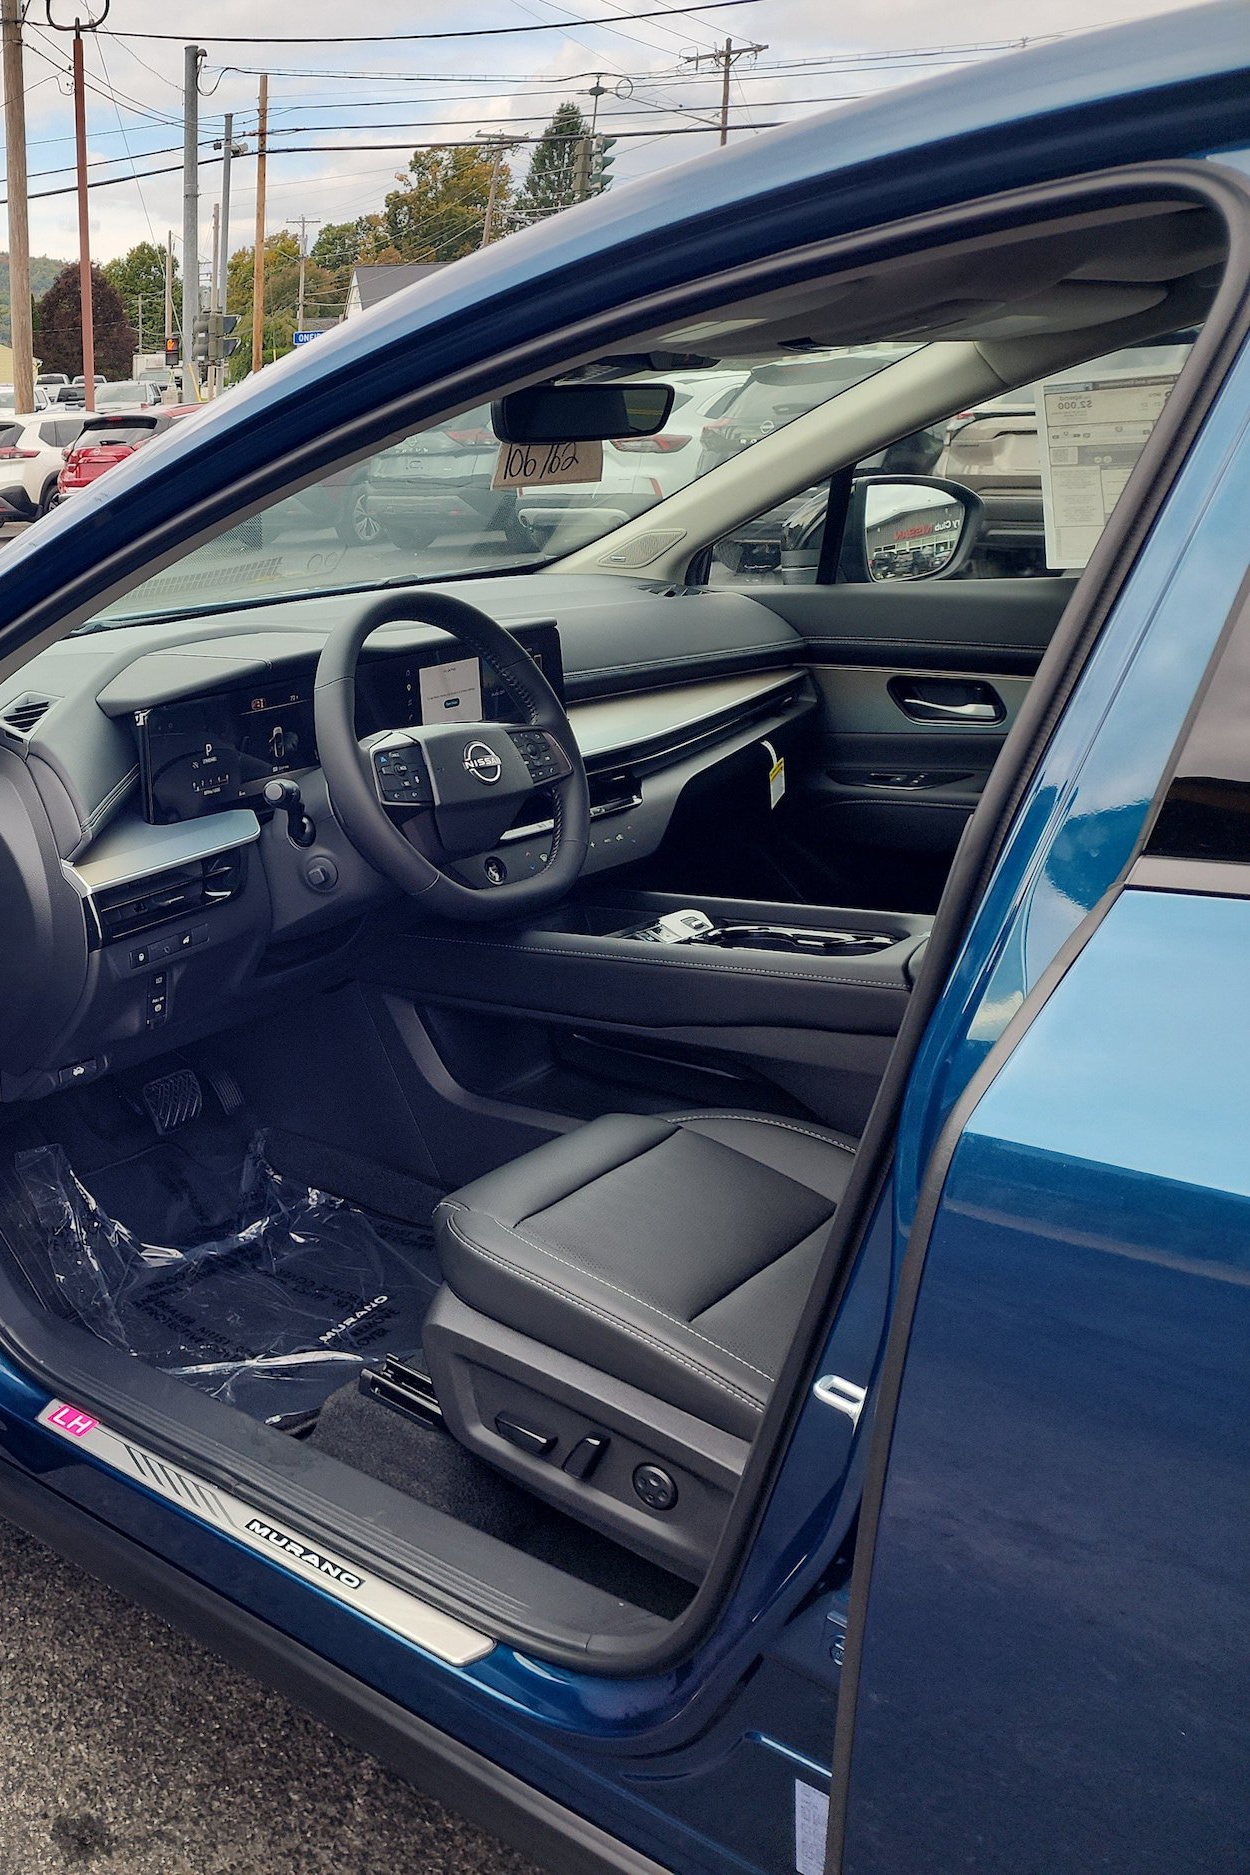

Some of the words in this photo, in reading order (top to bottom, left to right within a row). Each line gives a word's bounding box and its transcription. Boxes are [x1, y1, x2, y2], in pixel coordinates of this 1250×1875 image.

[464, 754, 501, 769] NISSAN
[318, 1294, 389, 1344] MURANO
[52, 1406, 92, 1435] LH
[249, 1519, 362, 1590] MURANO
